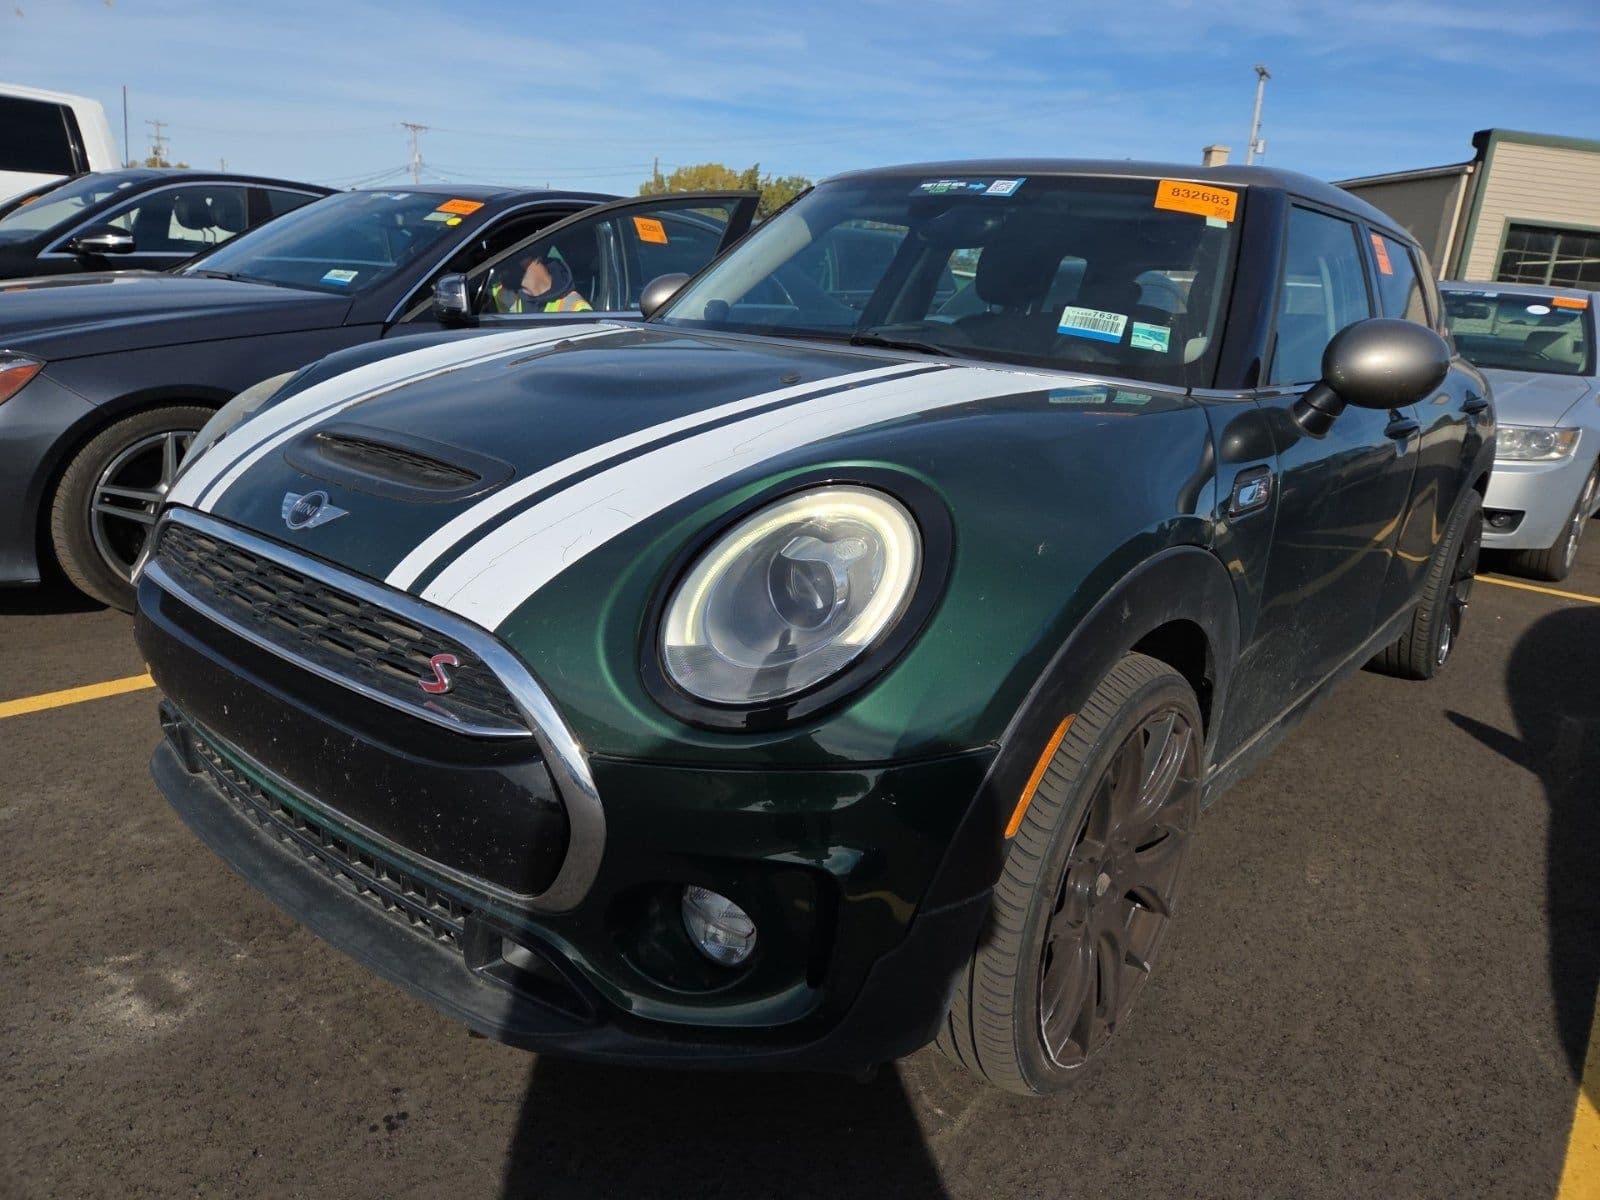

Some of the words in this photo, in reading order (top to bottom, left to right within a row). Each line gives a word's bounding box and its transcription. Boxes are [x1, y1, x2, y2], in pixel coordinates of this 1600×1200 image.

[1171, 187, 1230, 206] 832683
[294, 501, 319, 517] MINI
[418, 653, 459, 694] S
